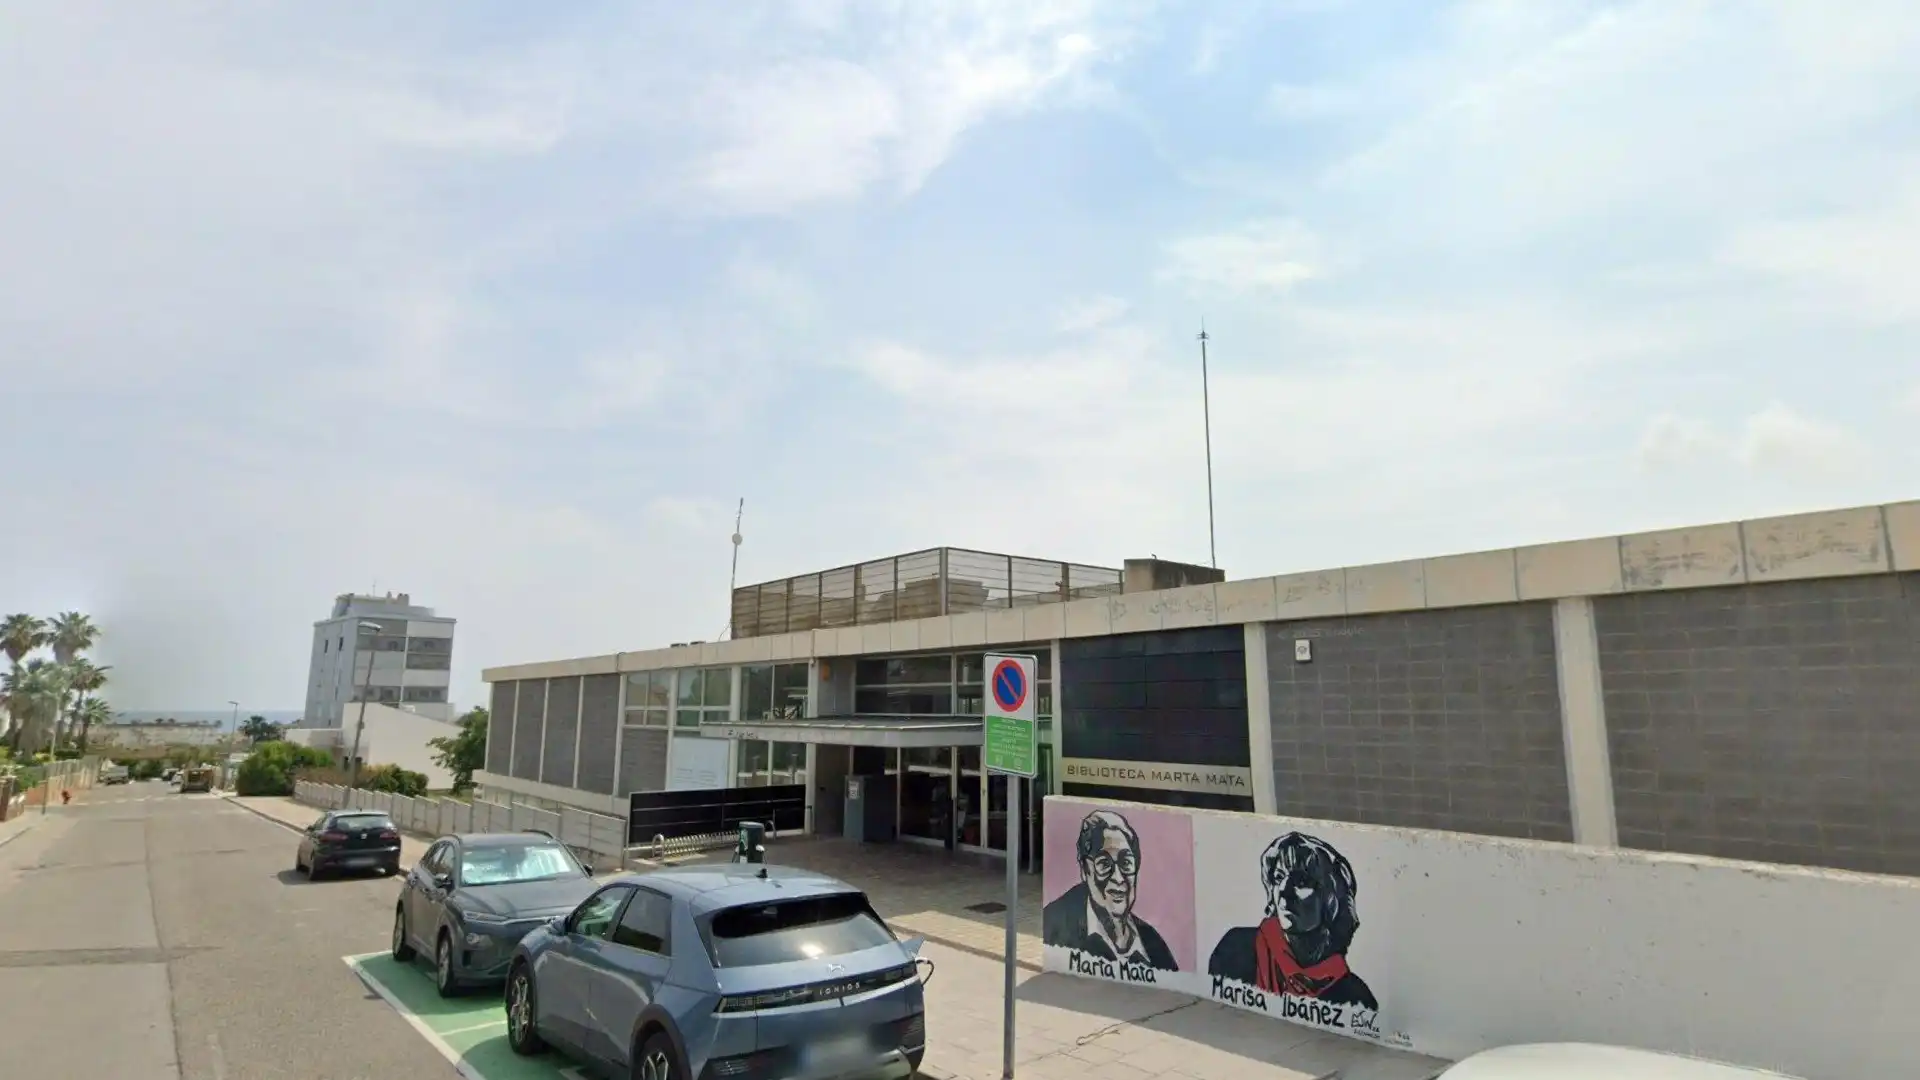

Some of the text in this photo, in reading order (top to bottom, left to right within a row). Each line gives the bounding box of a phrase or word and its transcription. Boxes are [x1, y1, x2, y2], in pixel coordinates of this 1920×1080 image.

[1066, 764, 1245, 788] BIBLIOTECA MARTA MATA
[1069, 951, 1157, 984] Marta Mata
[1212, 975, 1345, 1029] Marisa Ibáñez
